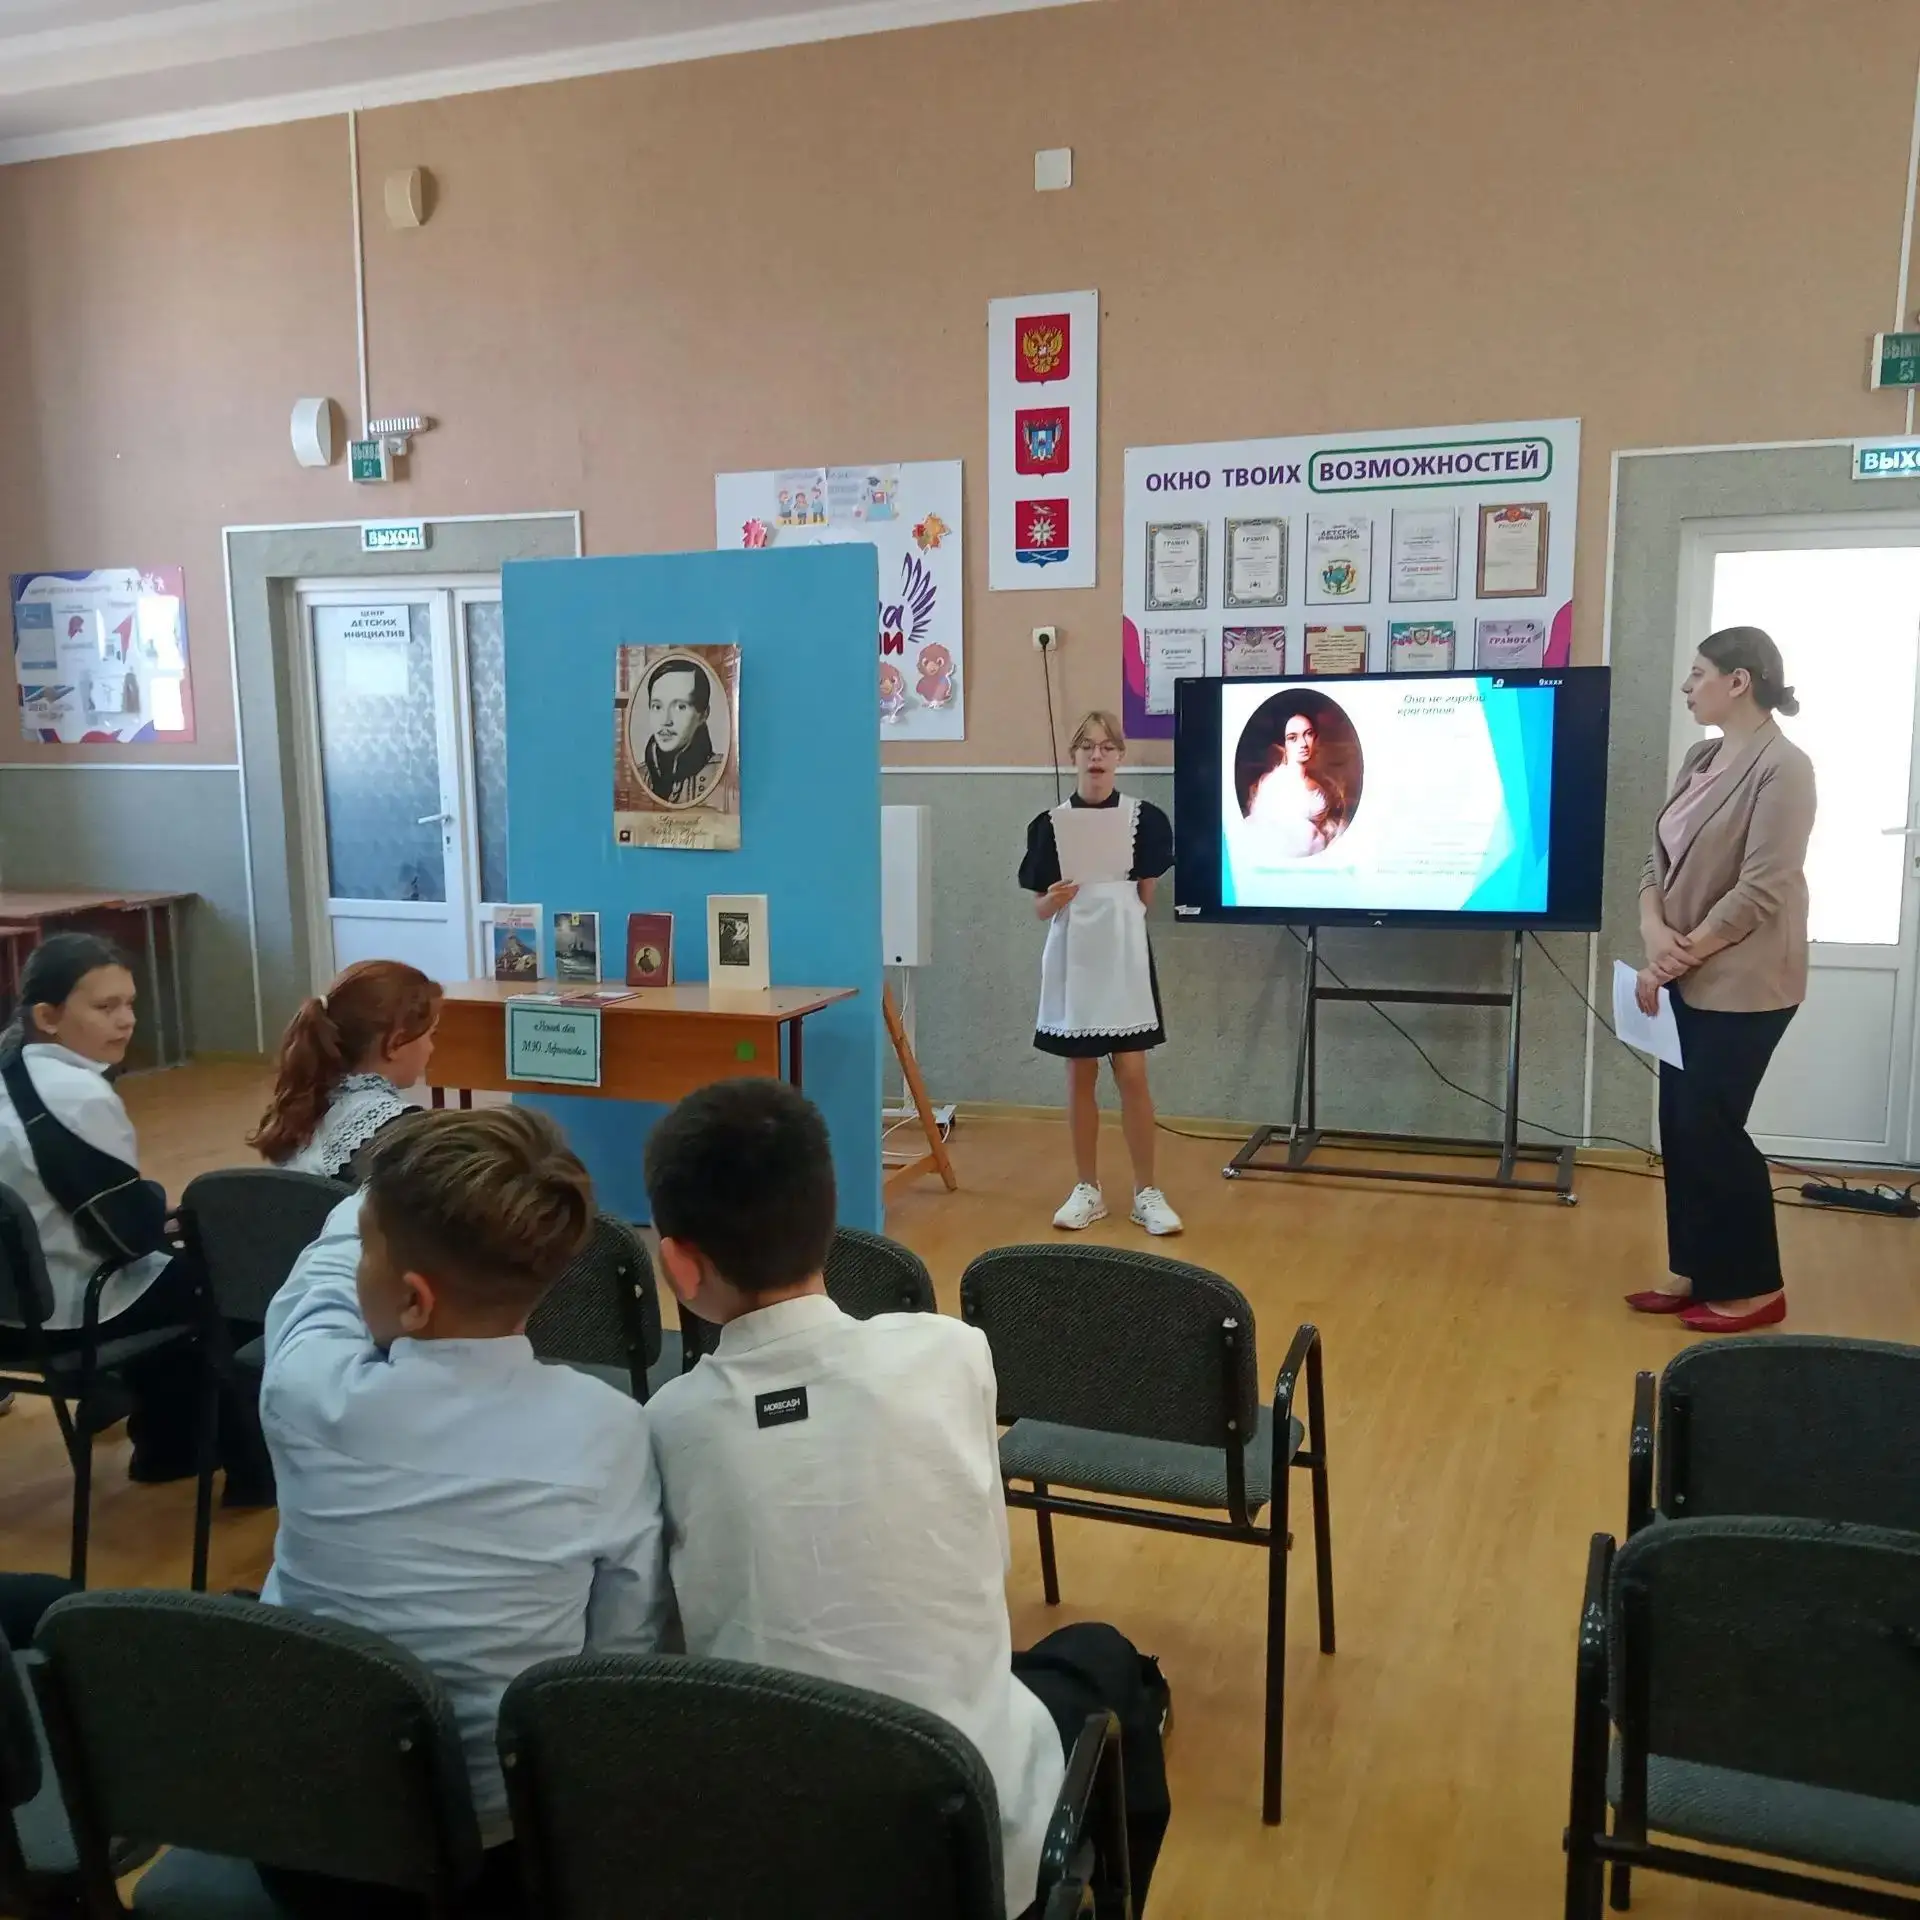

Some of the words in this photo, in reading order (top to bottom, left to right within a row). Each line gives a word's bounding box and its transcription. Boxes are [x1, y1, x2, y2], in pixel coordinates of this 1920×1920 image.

[1146, 470, 1211, 492] ОКНО
[1222, 464, 1301, 487] ТВОИХ
[1320, 444, 1539, 481] ВОЗМОЖНОСТЕЙ
[368, 527, 418, 547] ВЫХОД
[351, 619, 397, 628] ДЕТСКИХ
[343, 629, 405, 639] ИНИЦИАТИВ
[1489, 636, 1532, 645] ГРАМОТА
